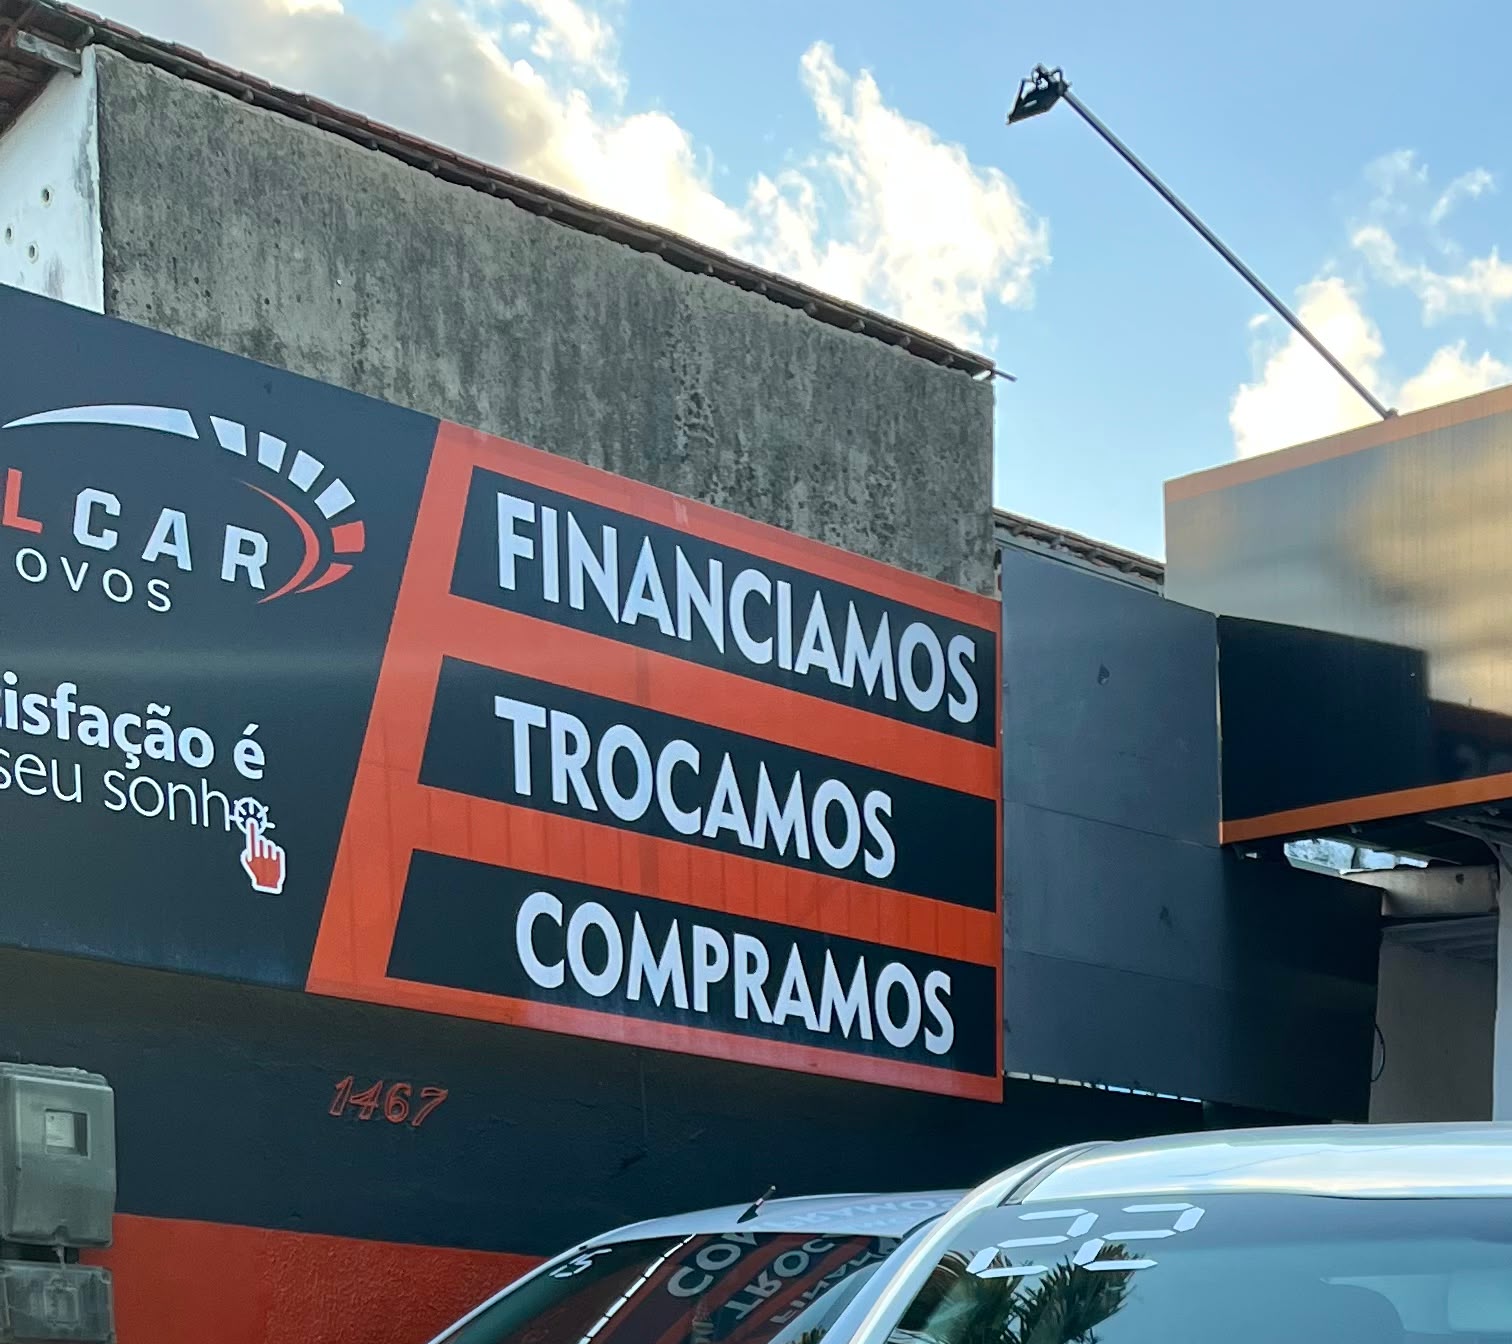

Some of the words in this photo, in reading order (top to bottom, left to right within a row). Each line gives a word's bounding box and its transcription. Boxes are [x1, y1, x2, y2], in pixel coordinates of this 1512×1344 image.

[15, 547, 172, 612] OVOS
[497, 492, 979, 724] FINANCIAMOS
[0, 670, 215, 770] isfação
[233, 722, 266, 780] é
[494, 695, 896, 879] TROCAMOS
[515, 891, 955, 1056] COMPRAMOS
[328, 1075, 449, 1127] 1467
[966, 1201, 1206, 1279] 22
